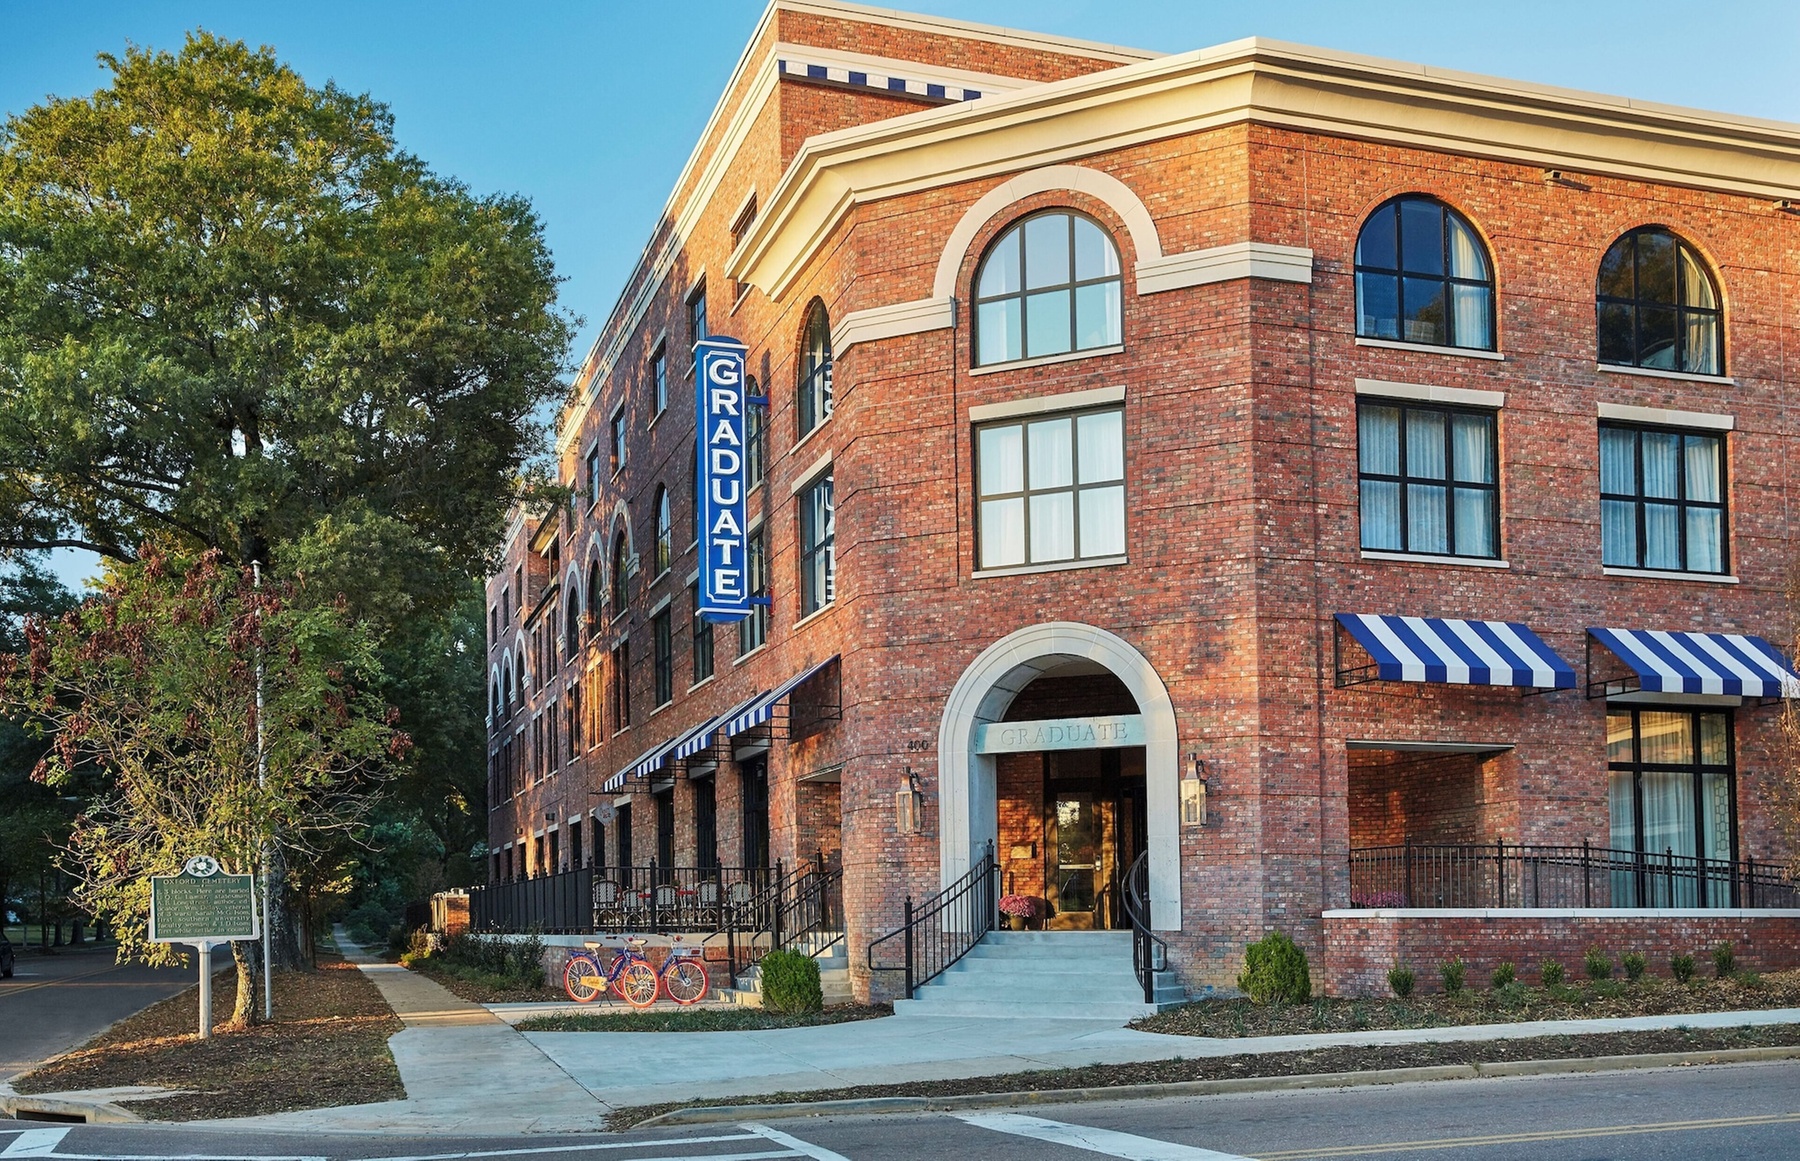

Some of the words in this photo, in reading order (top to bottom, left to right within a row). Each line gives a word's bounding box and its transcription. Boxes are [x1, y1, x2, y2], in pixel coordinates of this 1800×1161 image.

[708, 359, 742, 597] GRADUATE
[908, 740, 928, 750] 400
[1001, 722, 1128, 746] GRADUATE
